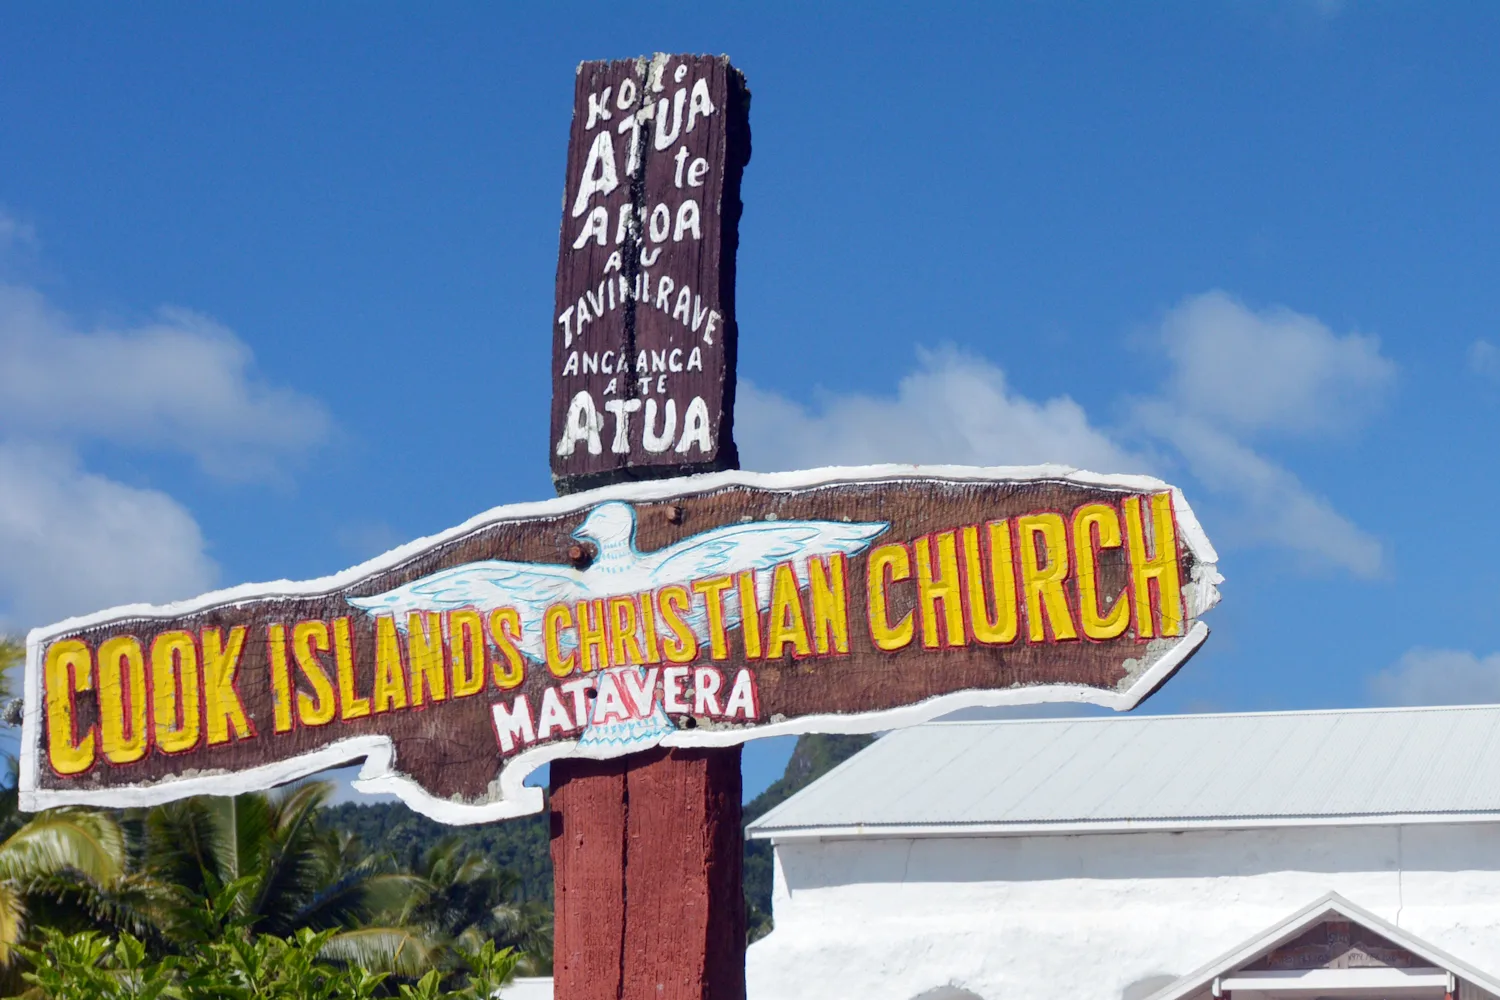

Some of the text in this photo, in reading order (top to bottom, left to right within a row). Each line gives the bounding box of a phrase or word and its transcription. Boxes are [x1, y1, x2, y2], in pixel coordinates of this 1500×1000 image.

[572, 77, 715, 217] ATUA
[674, 145, 709, 188] te
[556, 390, 712, 455] ATUA
[44, 490, 1184, 777] COOK ISLANDS CHRISTIAN CHURCH
[492, 667, 758, 756] MATAVERA
